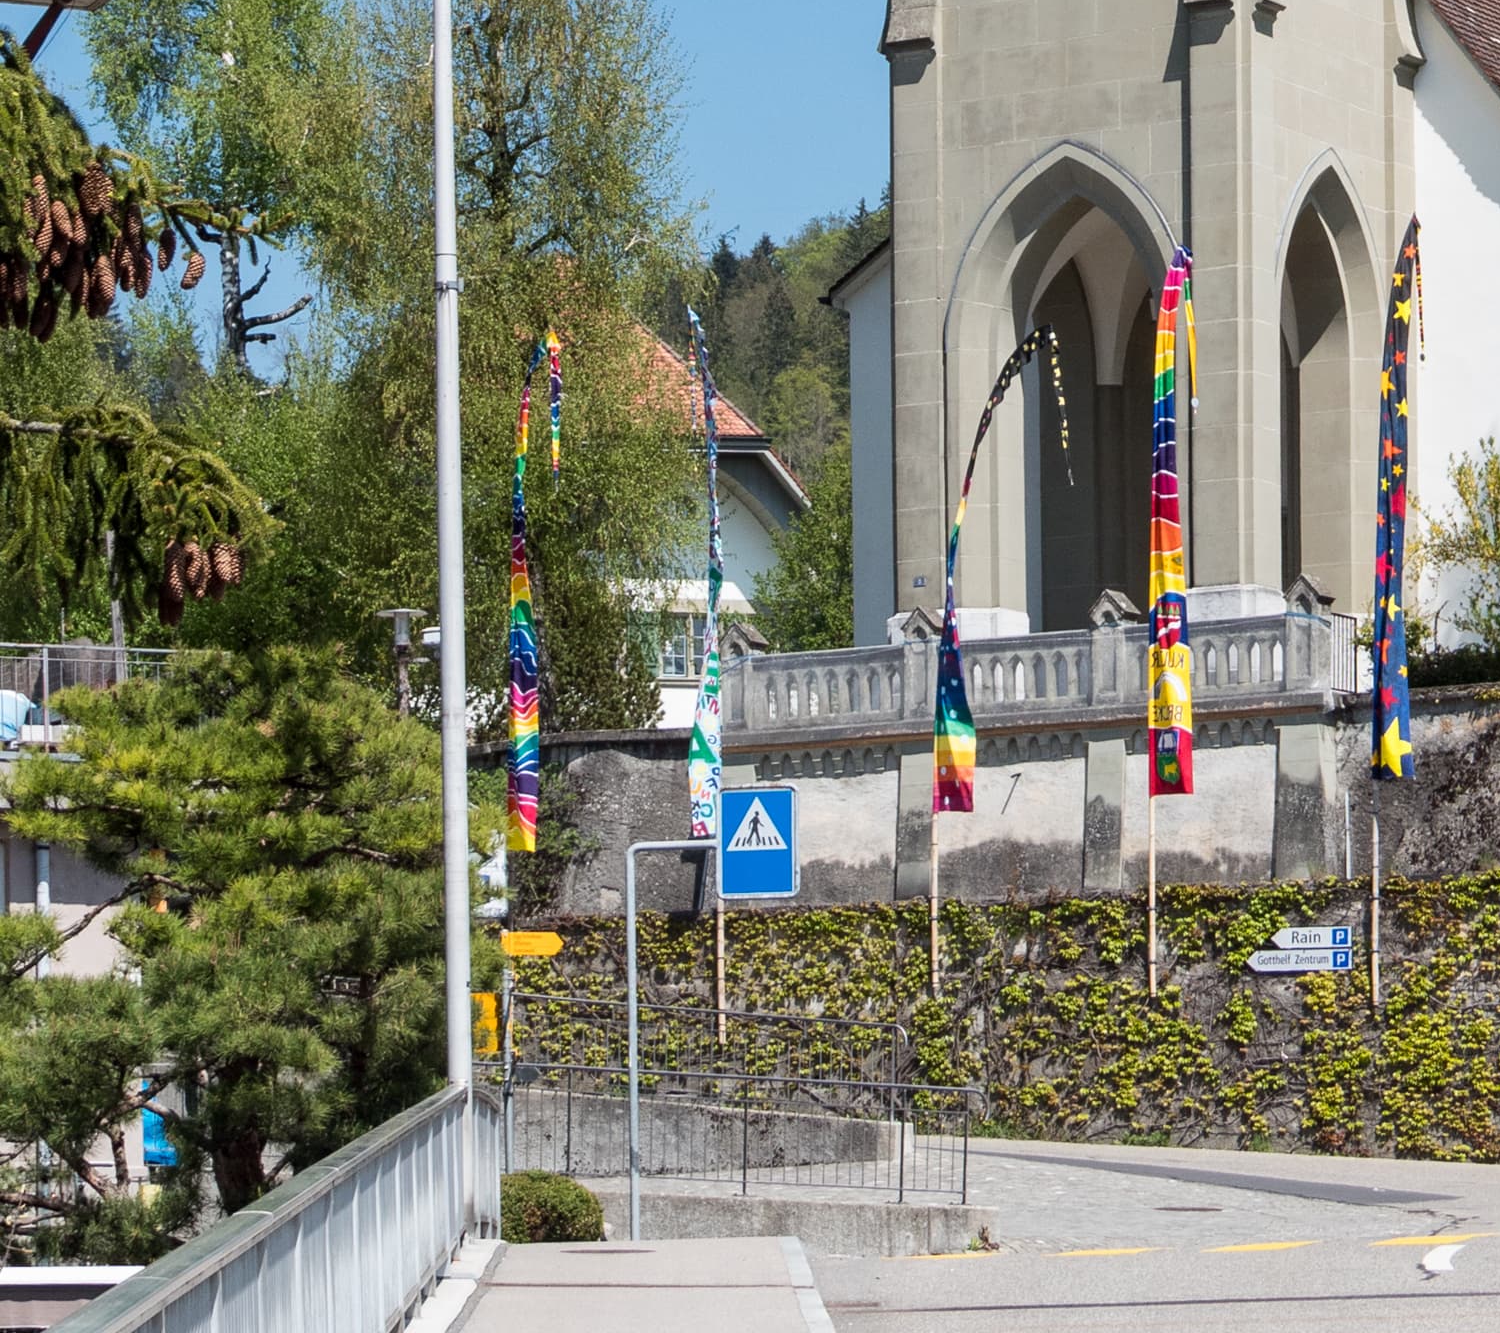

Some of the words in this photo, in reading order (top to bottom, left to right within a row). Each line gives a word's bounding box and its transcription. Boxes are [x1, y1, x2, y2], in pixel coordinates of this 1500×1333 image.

[1291, 930, 1321, 944] Rain
[1257, 953, 1291, 965] Gotthelf
[1295, 954, 1329, 965] Zentrum
